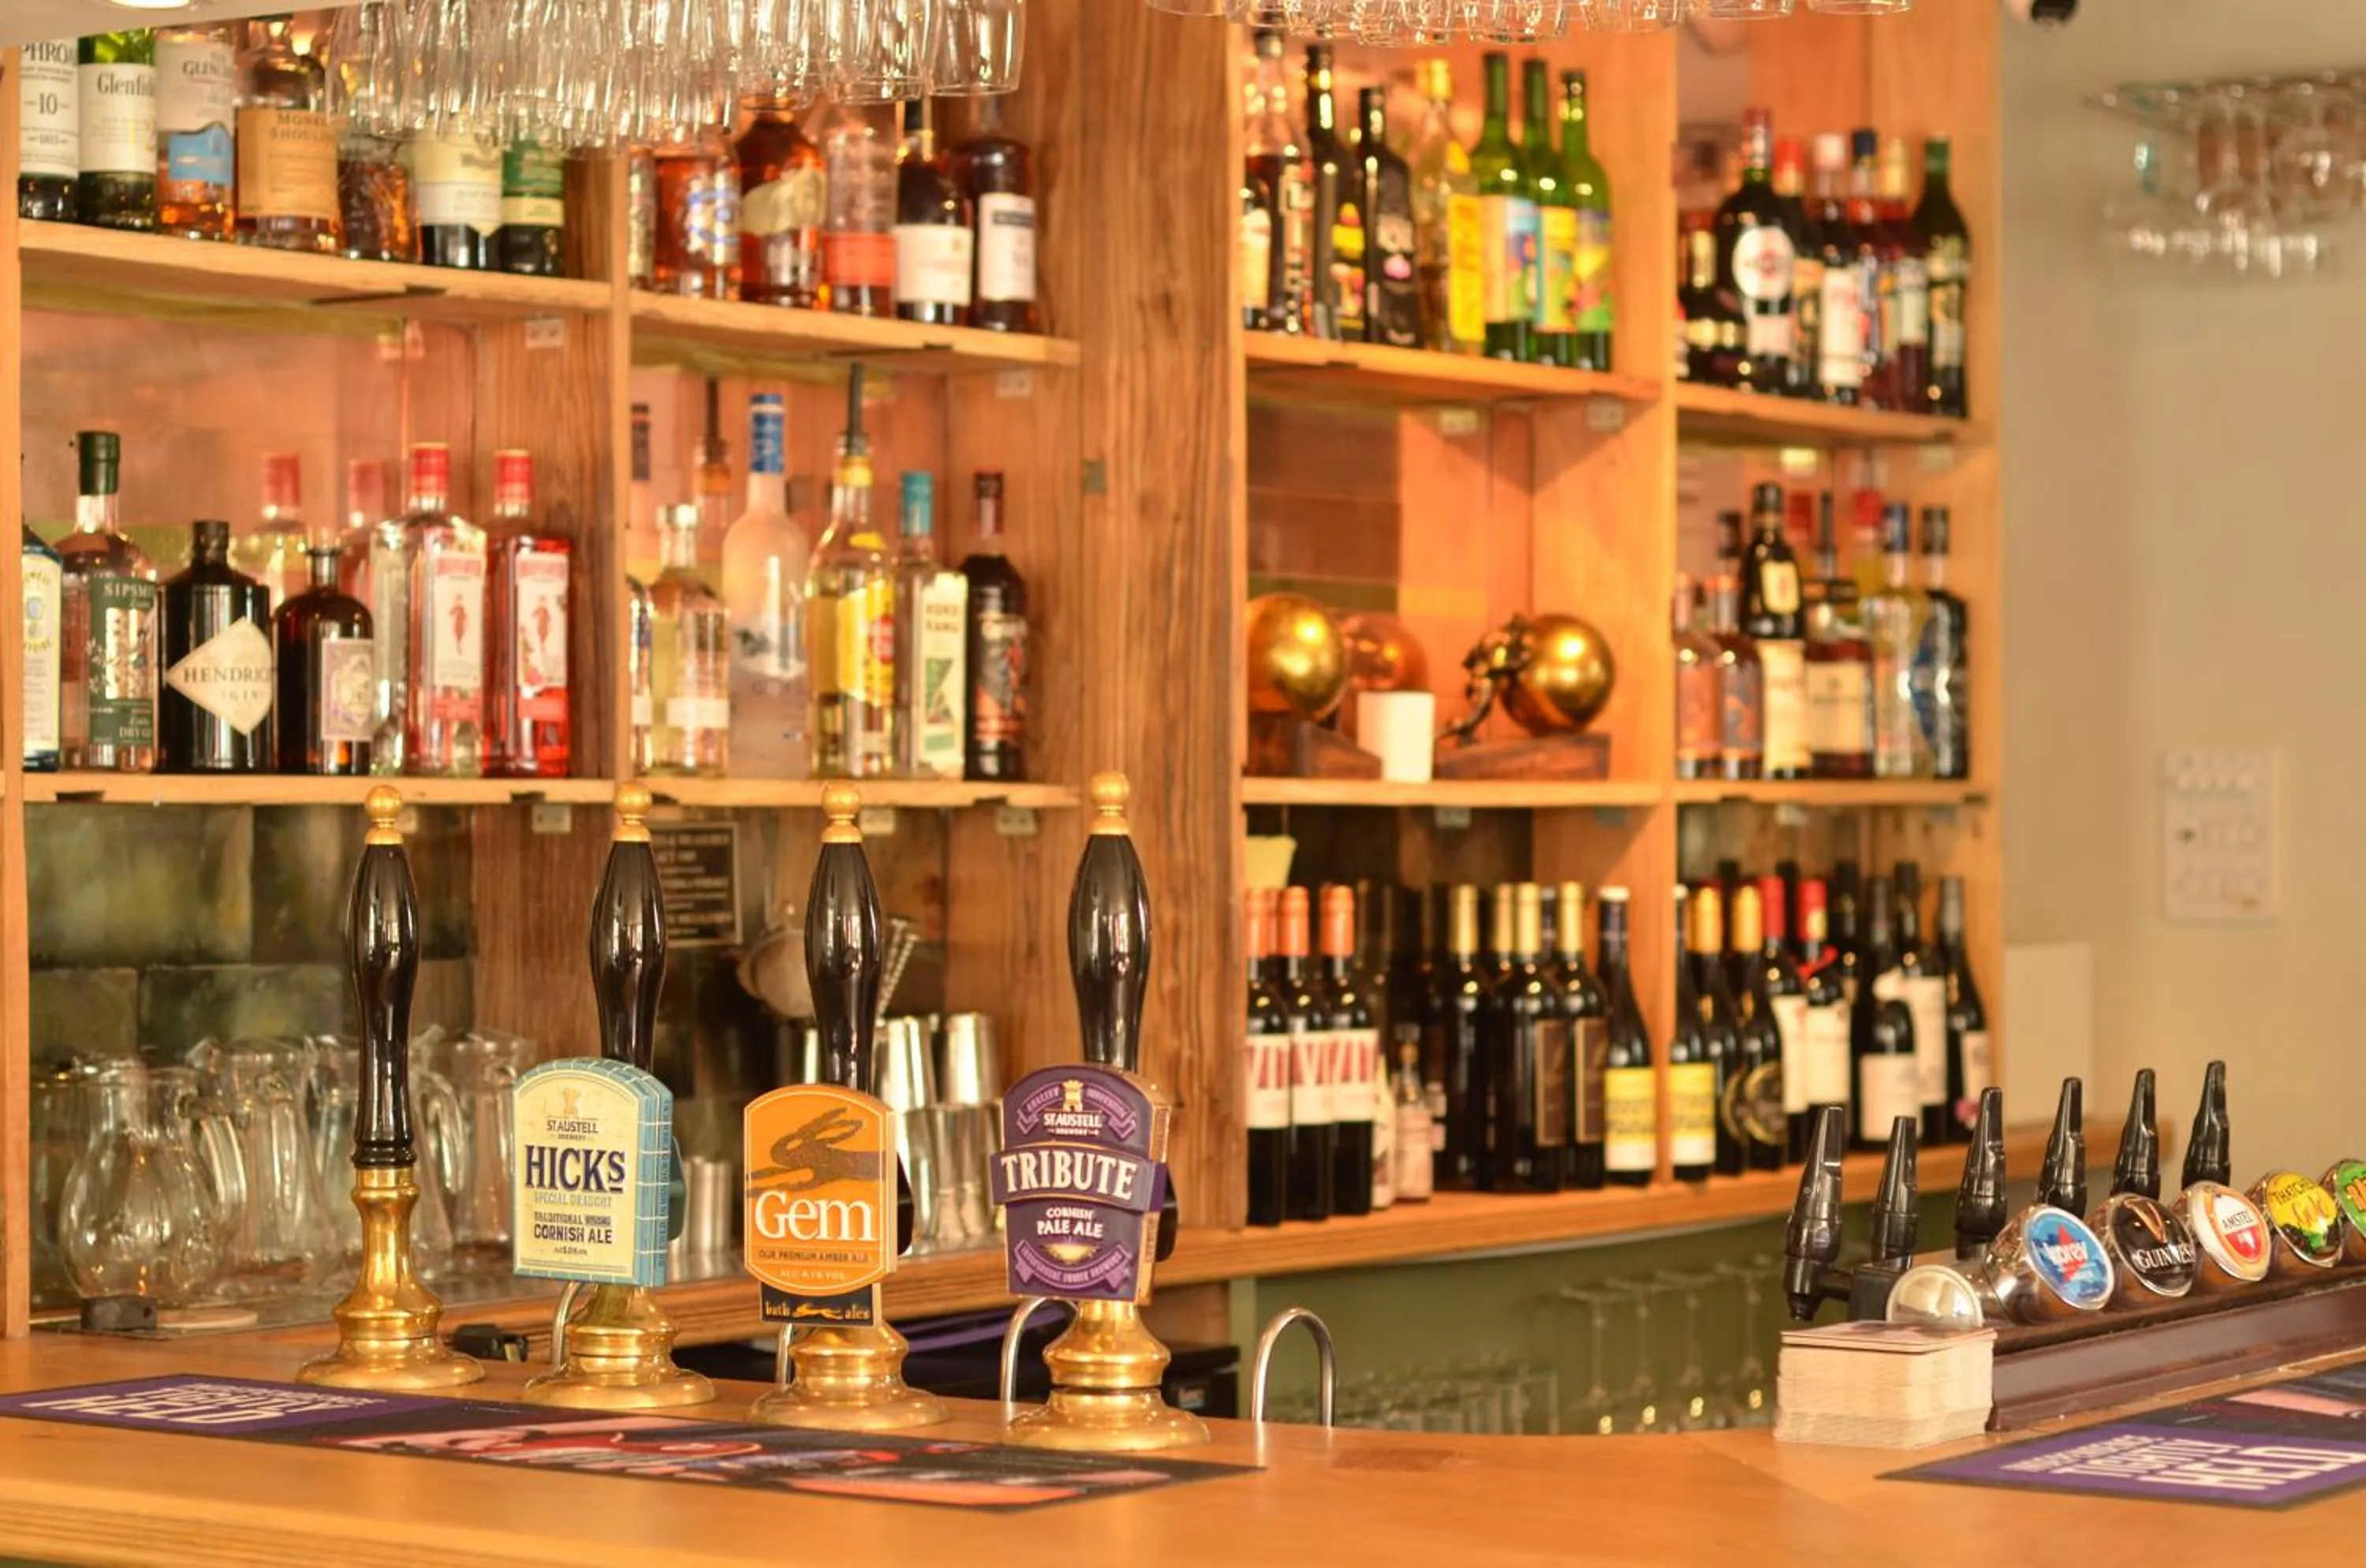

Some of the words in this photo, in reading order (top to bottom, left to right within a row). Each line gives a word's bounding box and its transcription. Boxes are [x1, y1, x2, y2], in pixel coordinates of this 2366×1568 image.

[39, 91, 58, 114] 10
[524, 1144, 626, 1194] HICKS
[1001, 1151, 1136, 1200] TRIBUTE
[755, 1189, 879, 1242] Gem
[1046, 1207, 1095, 1220] CORNISH
[2220, 1210, 2254, 1230] AMSTEL
[534, 1223, 584, 1243] CORNISH
[588, 1227, 613, 1244] ALE
[1036, 1219, 1069, 1235] PALE
[1073, 1221, 1103, 1238] ALE
[2136, 1444, 2366, 1491] HELD
